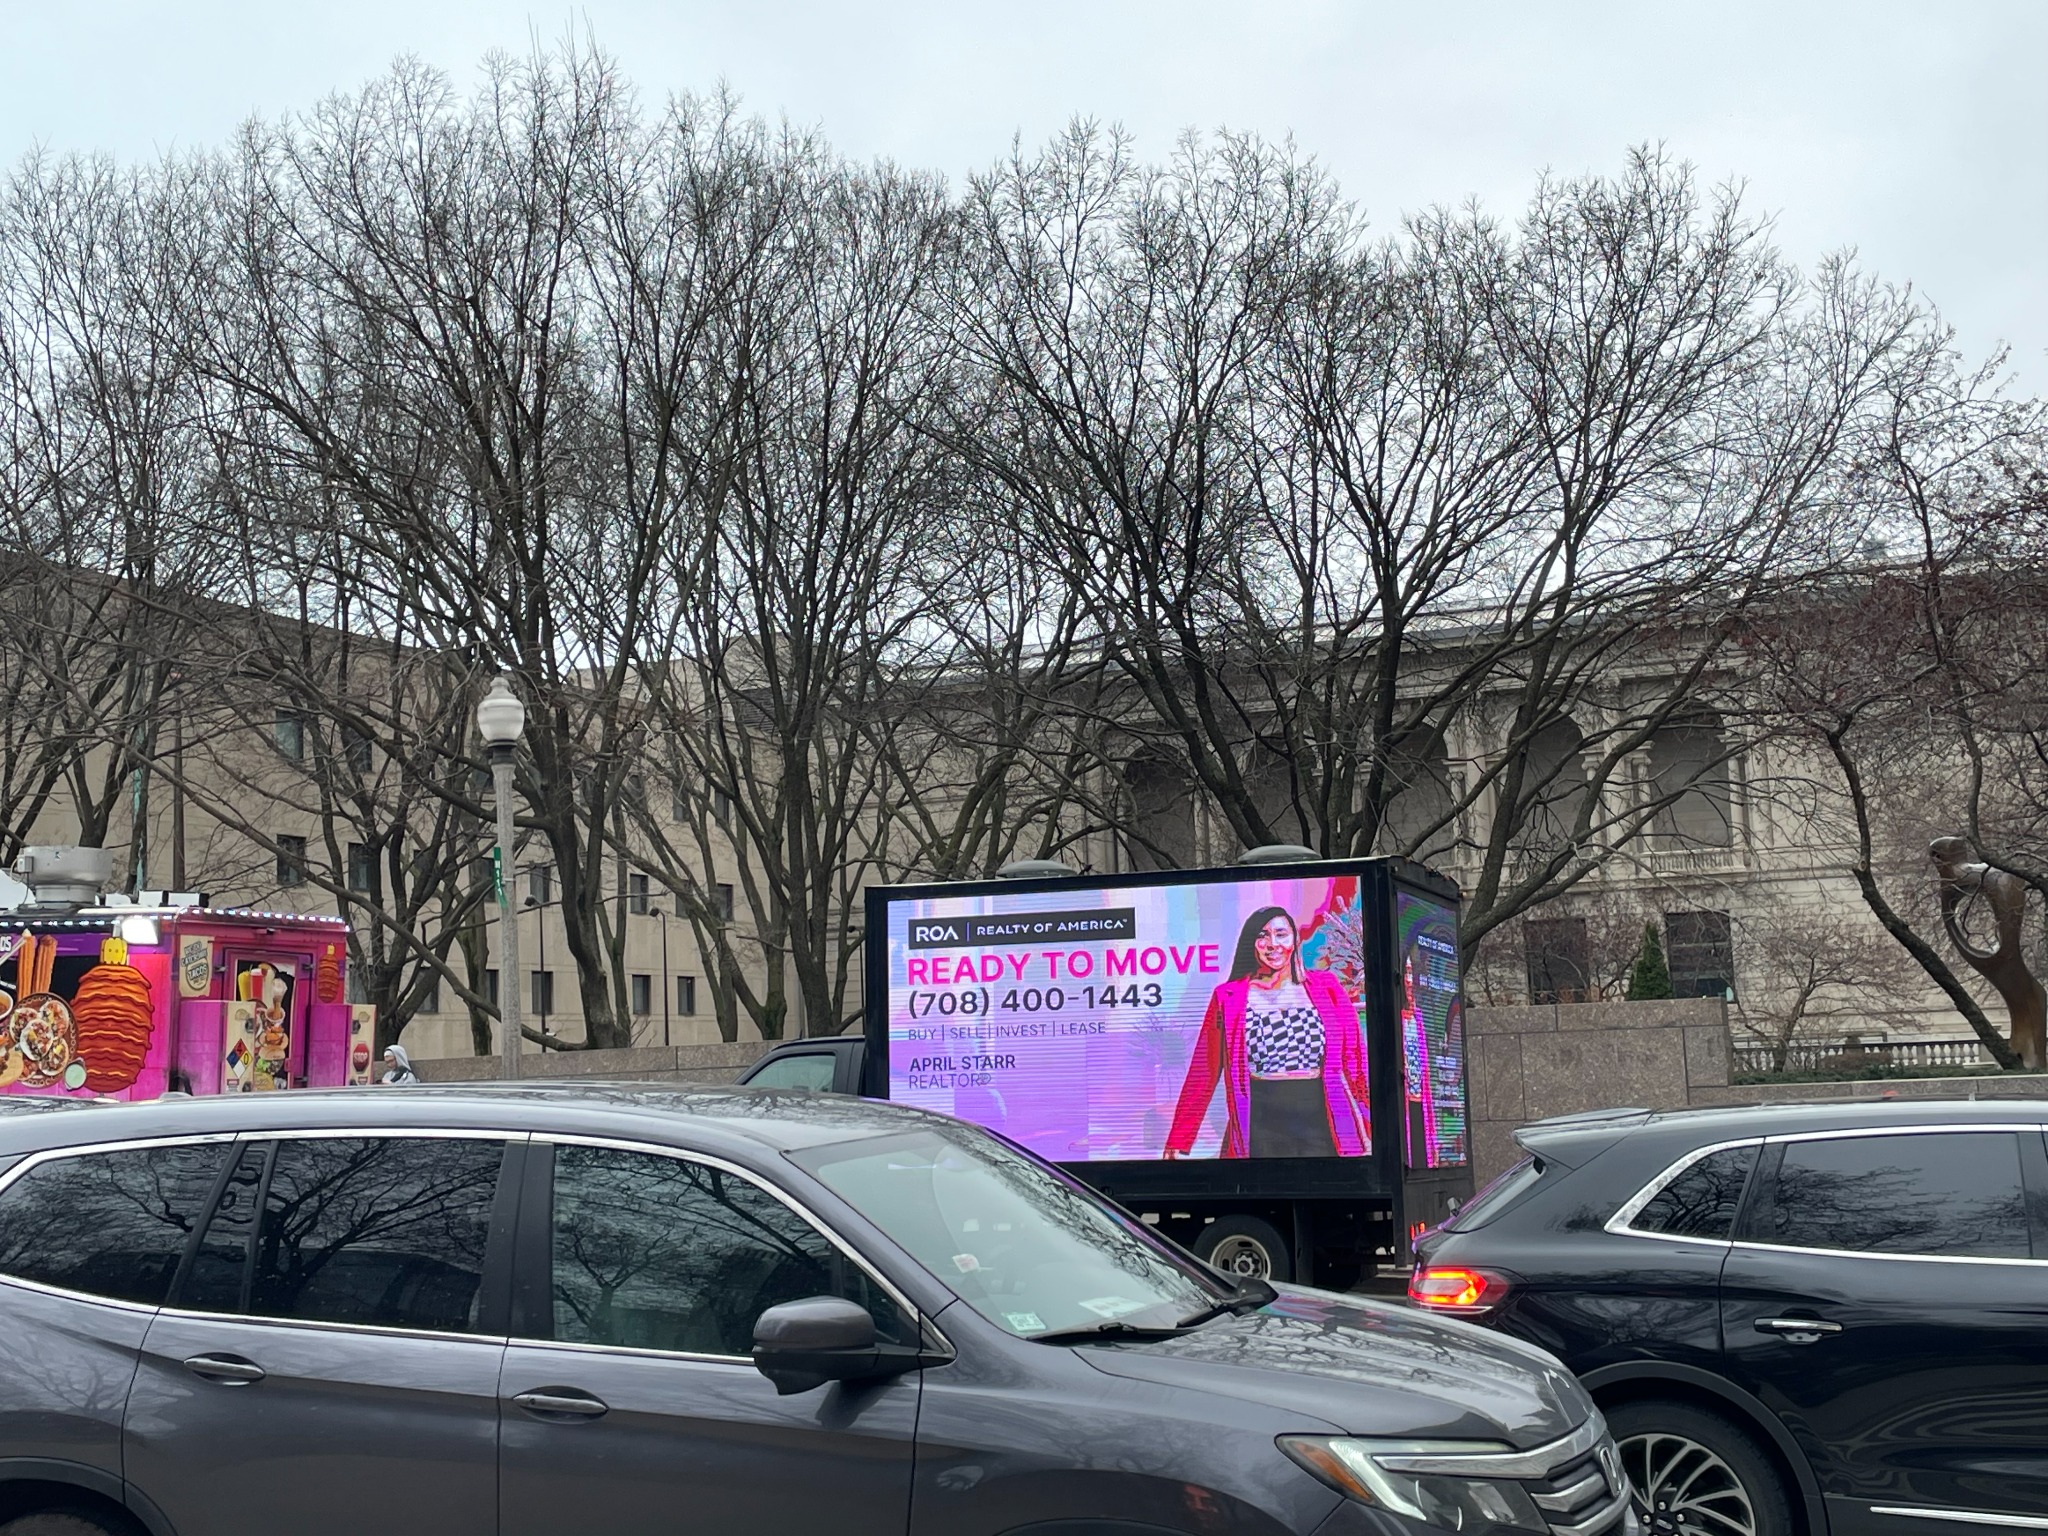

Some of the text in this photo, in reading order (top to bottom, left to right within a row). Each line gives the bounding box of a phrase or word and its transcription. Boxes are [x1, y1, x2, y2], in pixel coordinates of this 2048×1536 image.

[916, 926, 959, 942] ROA
[976, 923, 1030, 936] REALTY
[1034, 922, 1053, 934] OF
[908, 944, 1220, 986] READY TO MOVE
[908, 983, 1163, 1019] (708) 400-1443
[908, 1021, 1106, 1040] BUY SELL INVEST LEASE
[909, 1054, 1016, 1072] APRIL STARR
